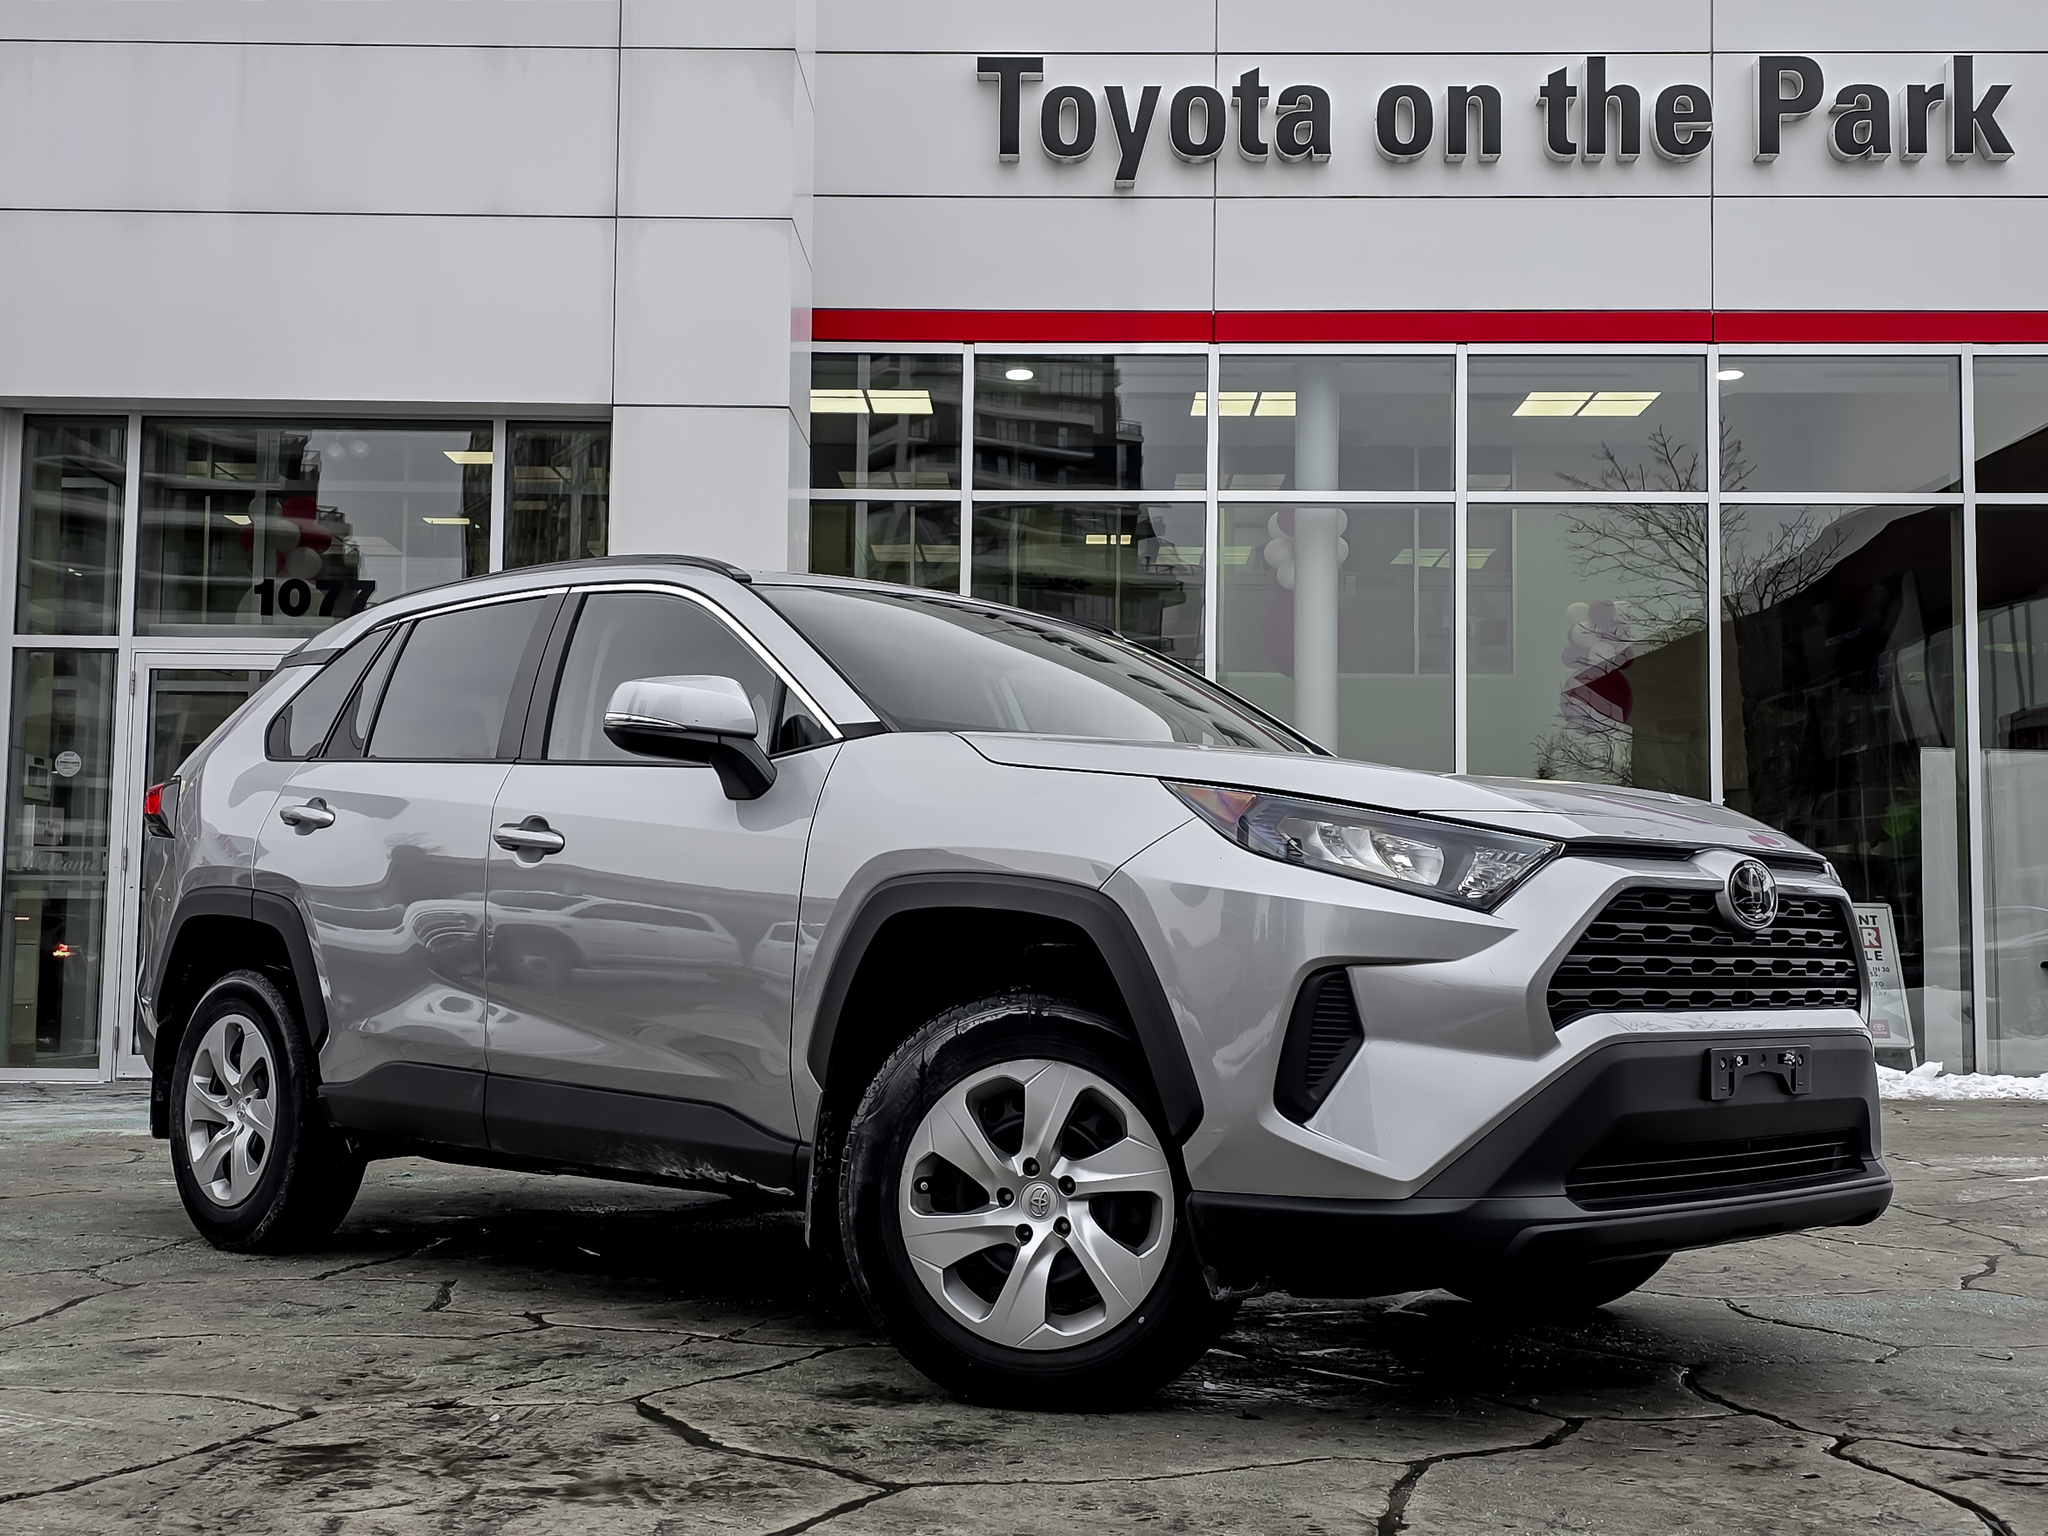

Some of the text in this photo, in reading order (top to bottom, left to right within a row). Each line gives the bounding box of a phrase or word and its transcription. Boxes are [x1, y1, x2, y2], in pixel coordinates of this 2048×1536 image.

[977, 55, 2015, 188] Toyota on the Park
[254, 578, 376, 617] 1077
[16, 851, 101, 872] Welcome
